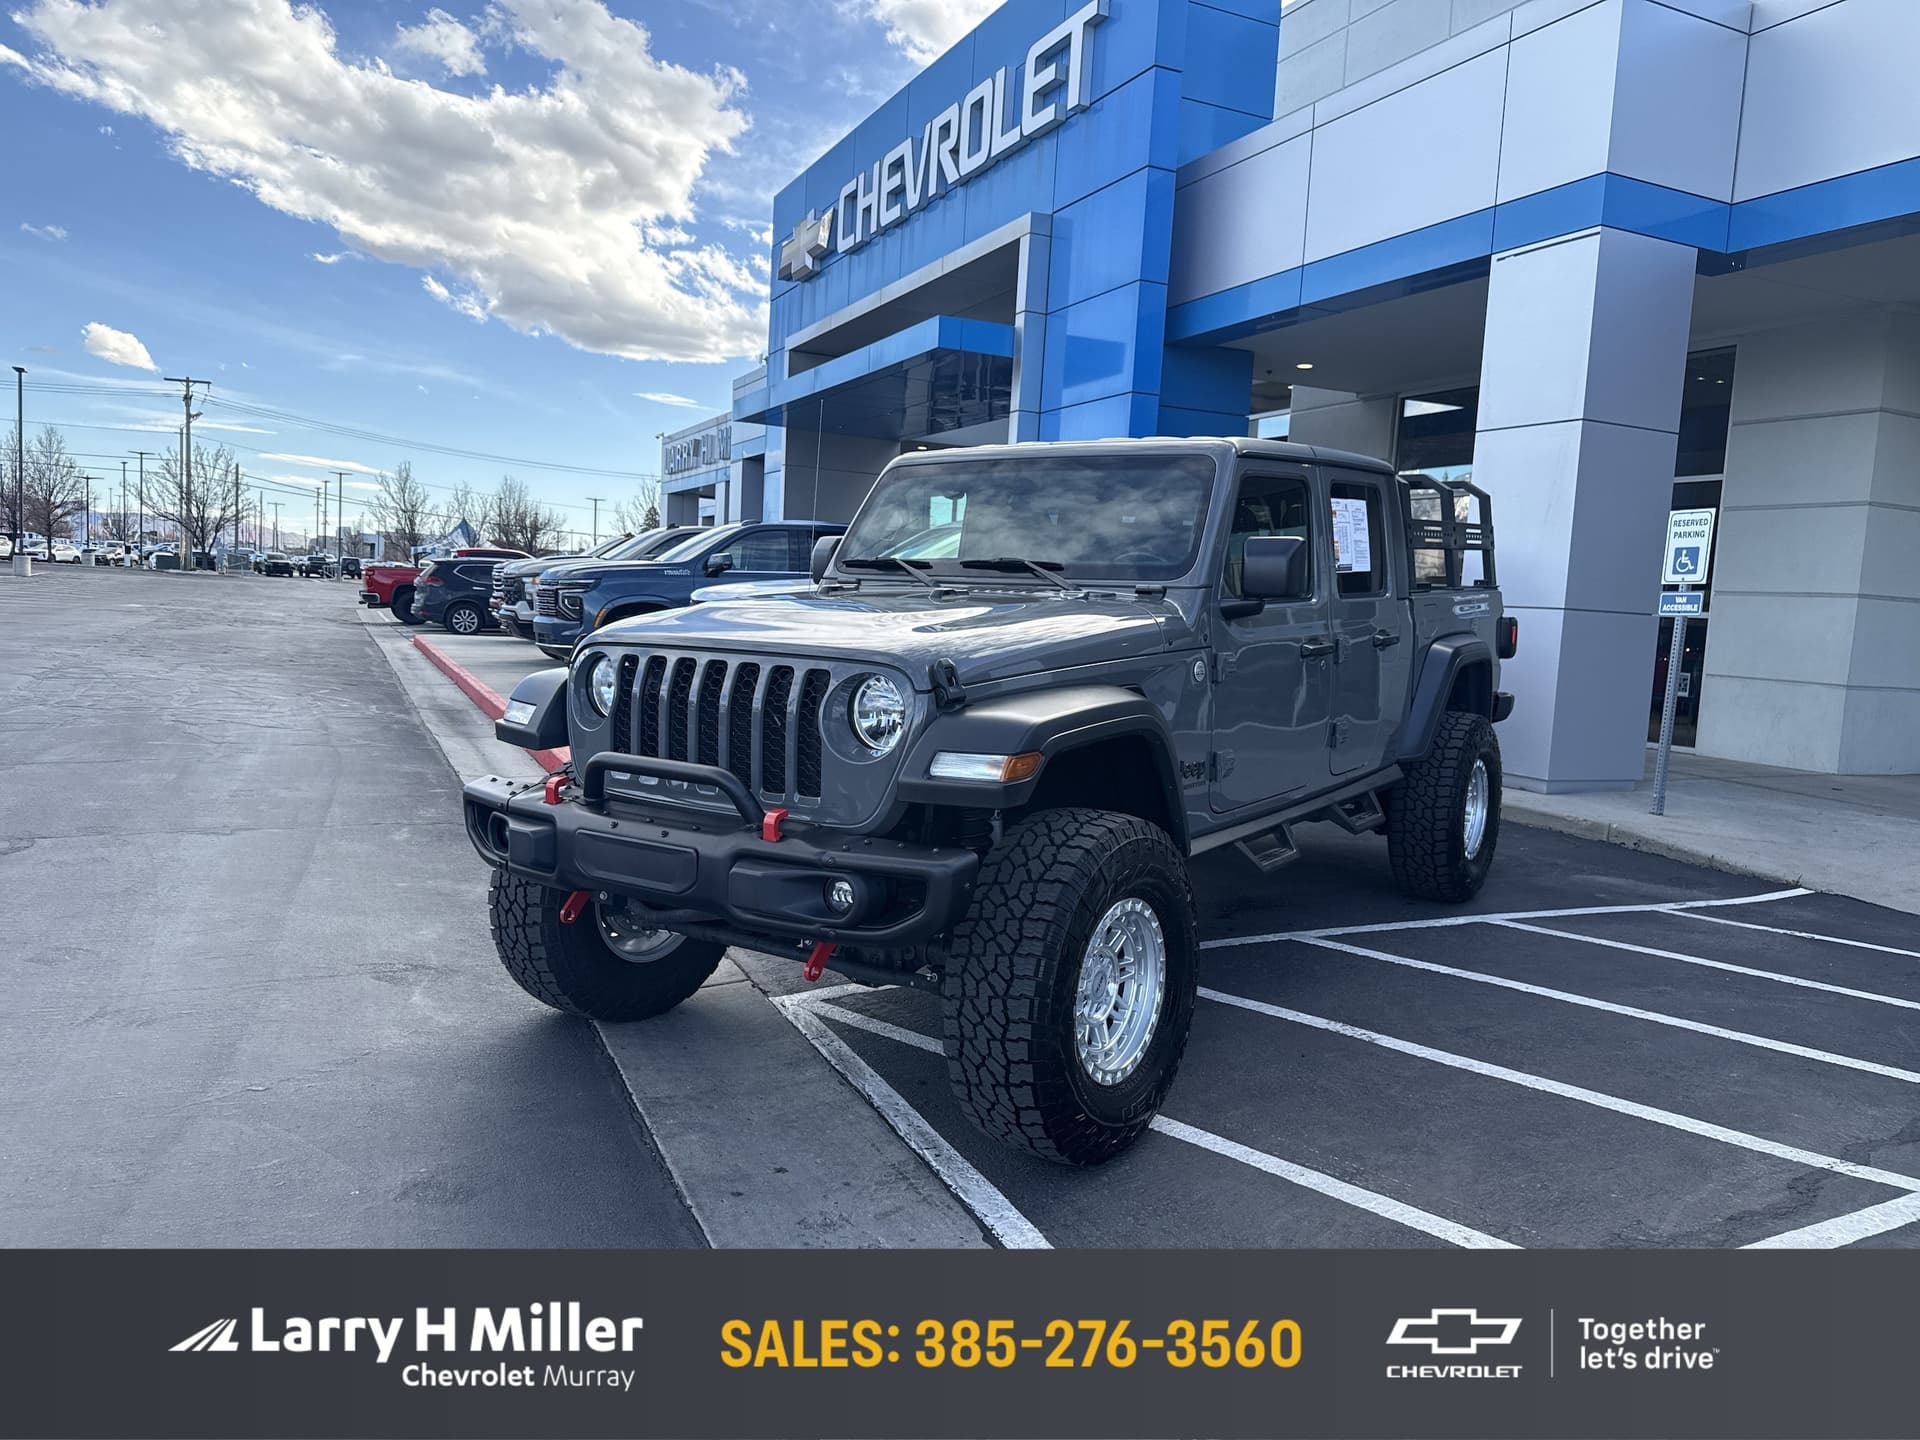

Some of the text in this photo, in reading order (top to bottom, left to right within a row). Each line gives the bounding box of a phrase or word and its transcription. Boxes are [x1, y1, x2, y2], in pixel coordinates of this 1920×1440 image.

[835, 0, 1109, 254] CHEVROLET
[663, 439, 700, 475] LARRY
[1673, 518, 1709, 527] RESERVED
[1673, 530, 1705, 539] PARKING
[1662, 604, 1699, 612] ACCESSIBLE
